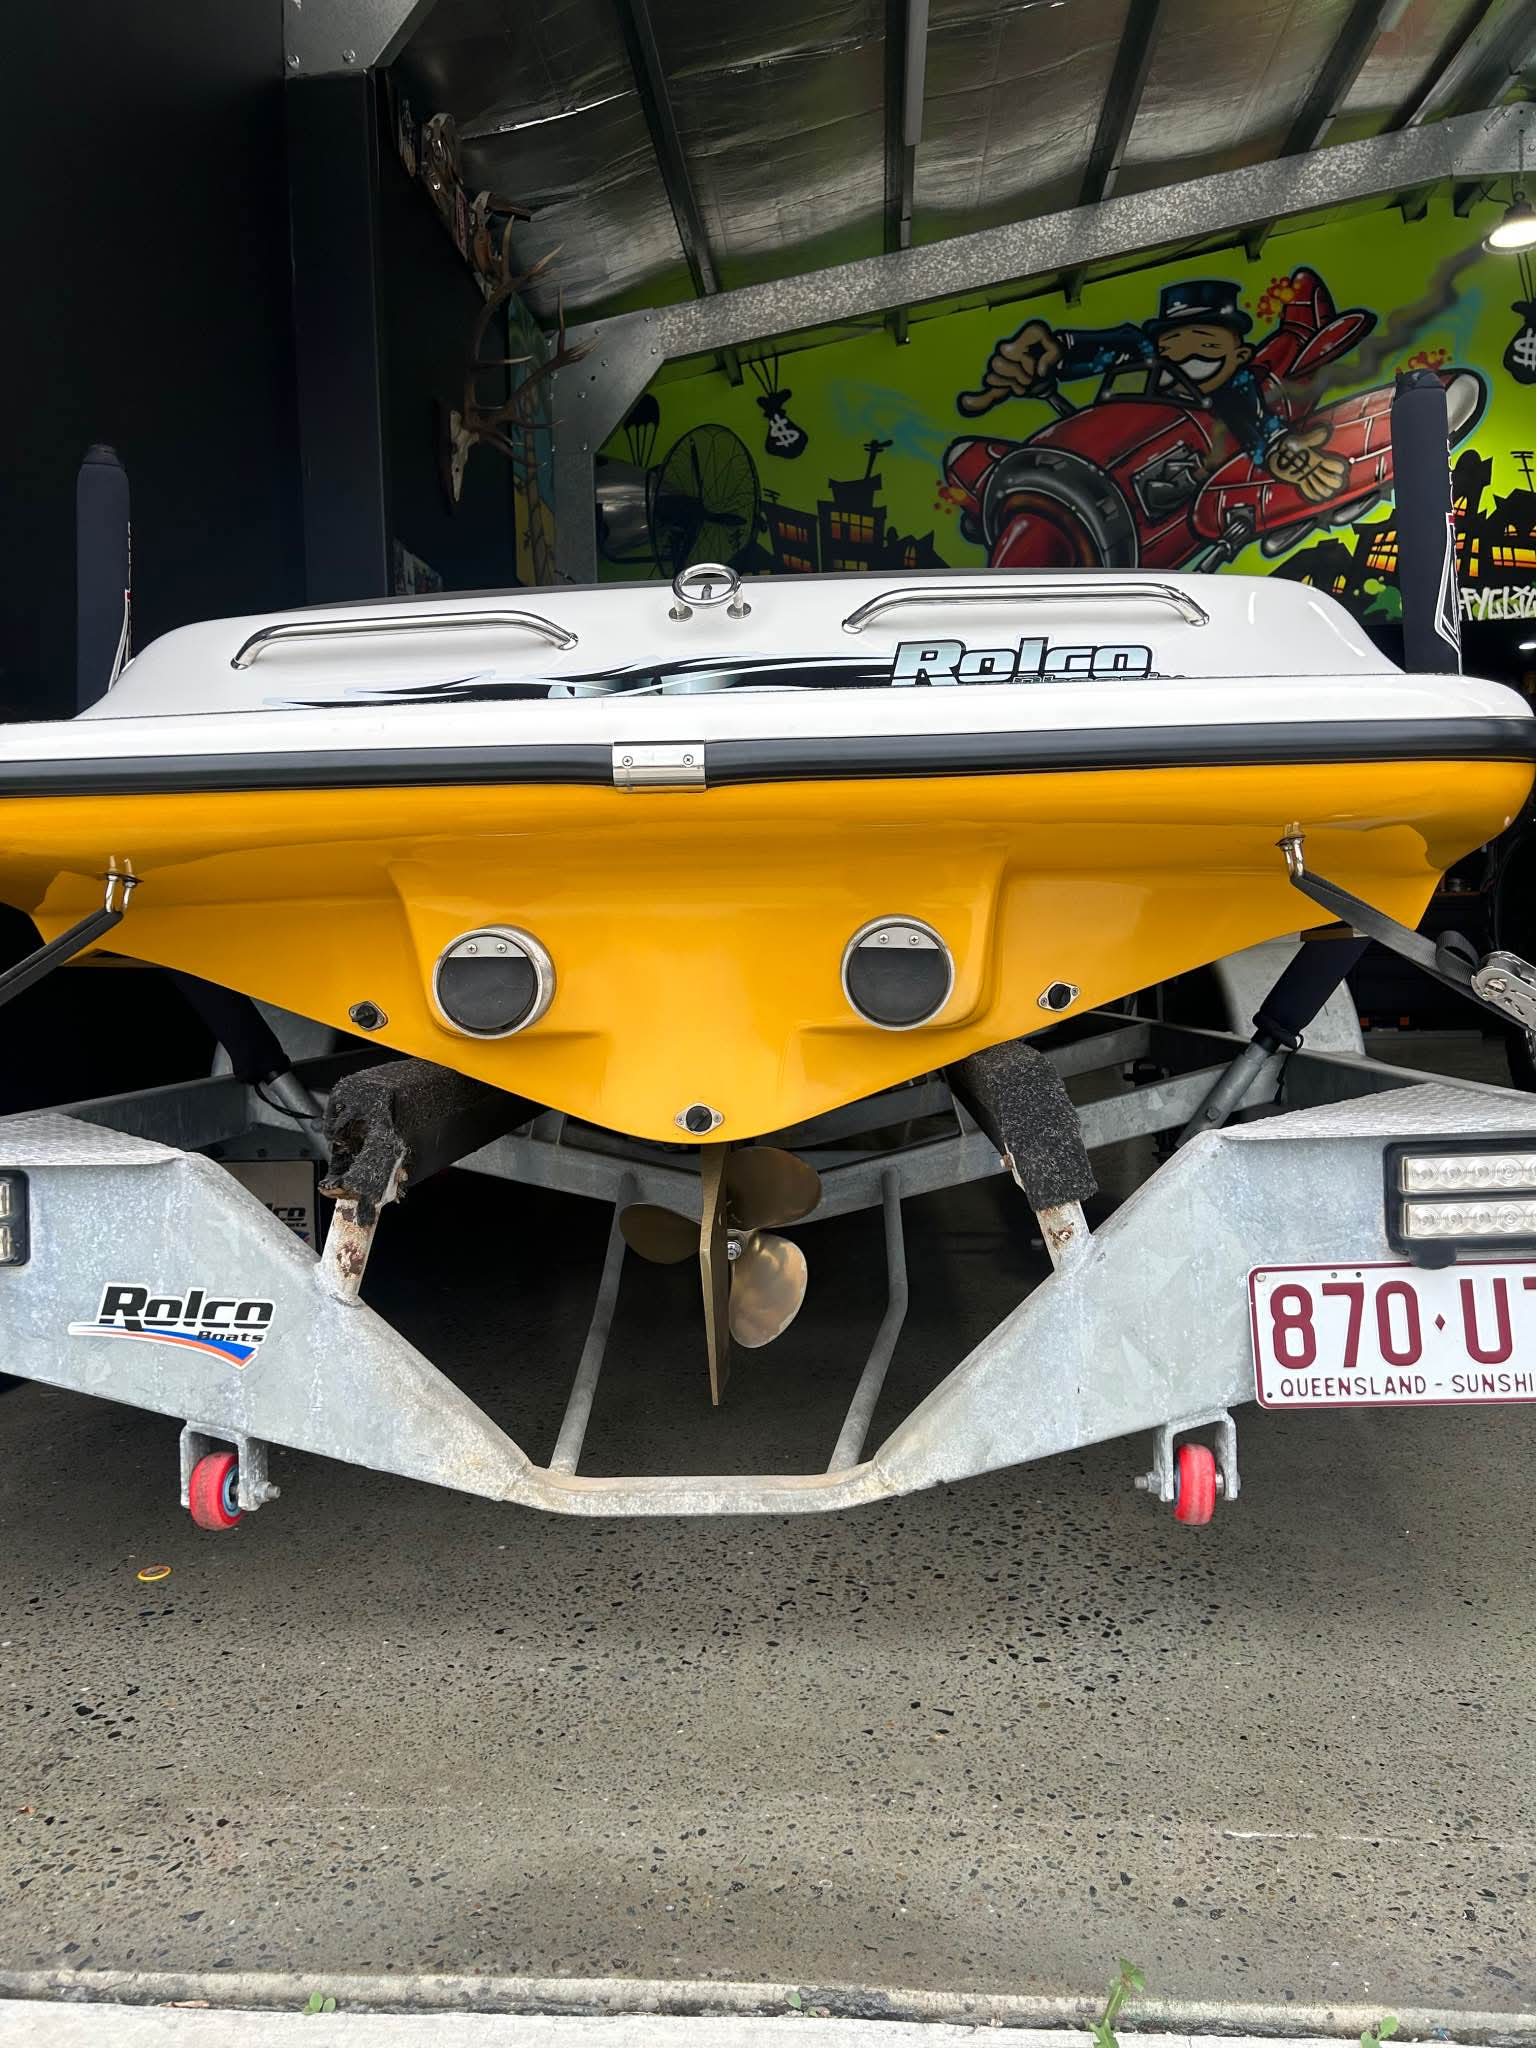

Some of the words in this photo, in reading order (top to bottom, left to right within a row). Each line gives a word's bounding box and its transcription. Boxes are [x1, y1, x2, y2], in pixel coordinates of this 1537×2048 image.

[891, 637, 1153, 687] Rolco
[99, 1286, 274, 1332] Rolco
[1459, 1276, 1535, 1364] U
[197, 1331, 264, 1343] Boats
[1280, 1375, 1427, 1397] QUEENSLAND
[1452, 1372, 1534, 1393] SUNSHI
